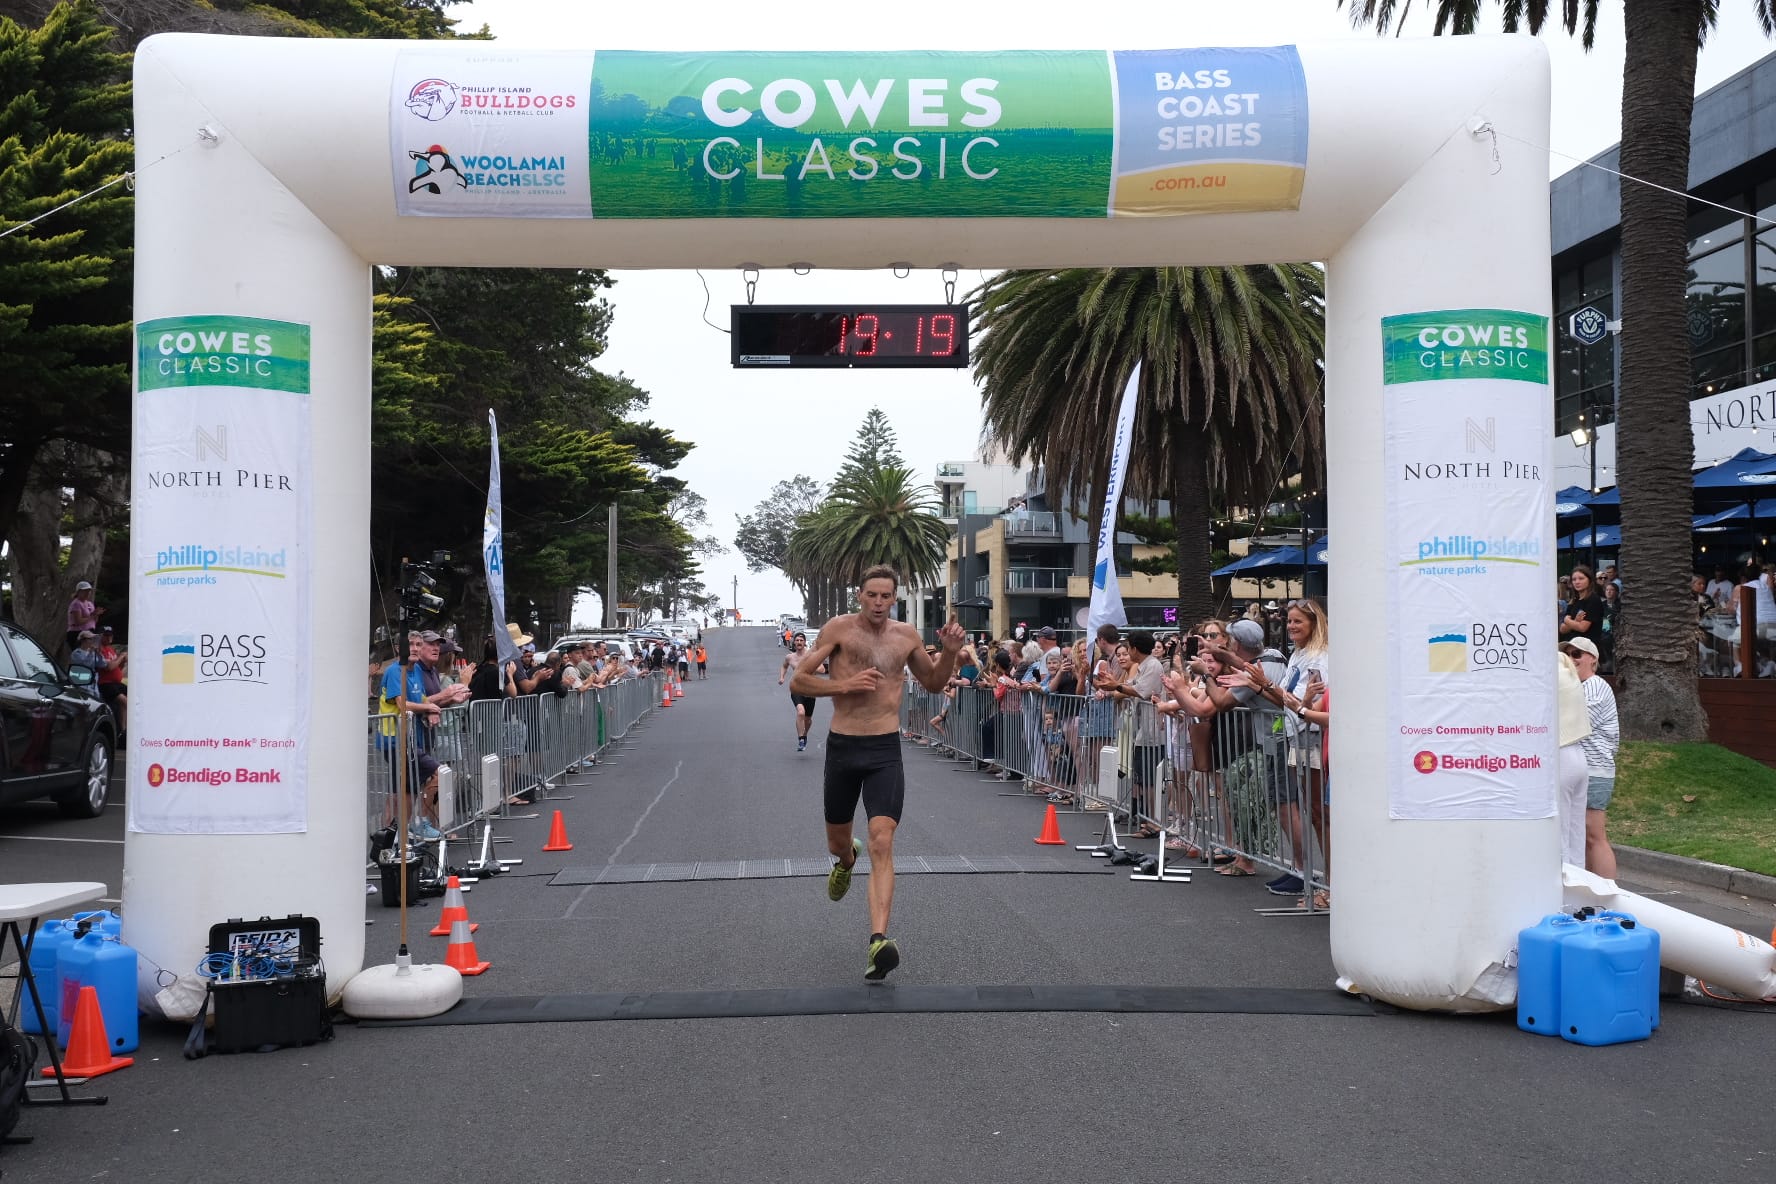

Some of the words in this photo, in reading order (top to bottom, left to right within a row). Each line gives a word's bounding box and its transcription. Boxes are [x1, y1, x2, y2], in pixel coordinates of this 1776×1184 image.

[1154, 69, 1232, 92] BASS
[460, 94, 576, 108] BULLDOGS
[701, 77, 1003, 129] COWES
[1157, 93, 1260, 120] COAST
[1157, 122, 1262, 151] SERIES
[460, 155, 565, 171] WOOLAMAI
[702, 136, 1000, 182] CLASSIC
[1149, 173, 1227, 192] .com.au
[1576, 311, 1603, 323] FURPHY
[158, 331, 273, 356] COWES
[1418, 325, 1528, 349] COWES
[159, 355, 273, 377] CLASSIC
[1420, 350, 1529, 368] CLASSIC
[148, 471, 222, 489] NORTH
[236, 469, 294, 492] PIER
[1404, 463, 1490, 481] NORTH
[1503, 460, 1541, 481] PIER
[1098, 416, 1126, 549] WESTERNPO
[157, 575, 186, 586] nature
[187, 573, 217, 587] parks
[1418, 566, 1455, 576] nature
[1456, 564, 1487, 577] parks
[1472, 623, 1528, 647] BASS
[200, 634, 267, 659] BASS
[1473, 648, 1528, 665] COAST
[200, 660, 266, 677] COAST
[1400, 726, 1433, 735] Cowes
[1435, 725, 1495, 736] Community
[1526, 725, 1548, 734] Branch
[140, 737, 163, 747] Cowes
[164, 738, 219, 749] Community
[260, 738, 296, 748] Branch
[1441, 754, 1507, 773] Bendigo
[1509, 754, 1541, 769] Bank
[167, 767, 232, 786] Bendigo
[236, 768, 281, 783] Bank
